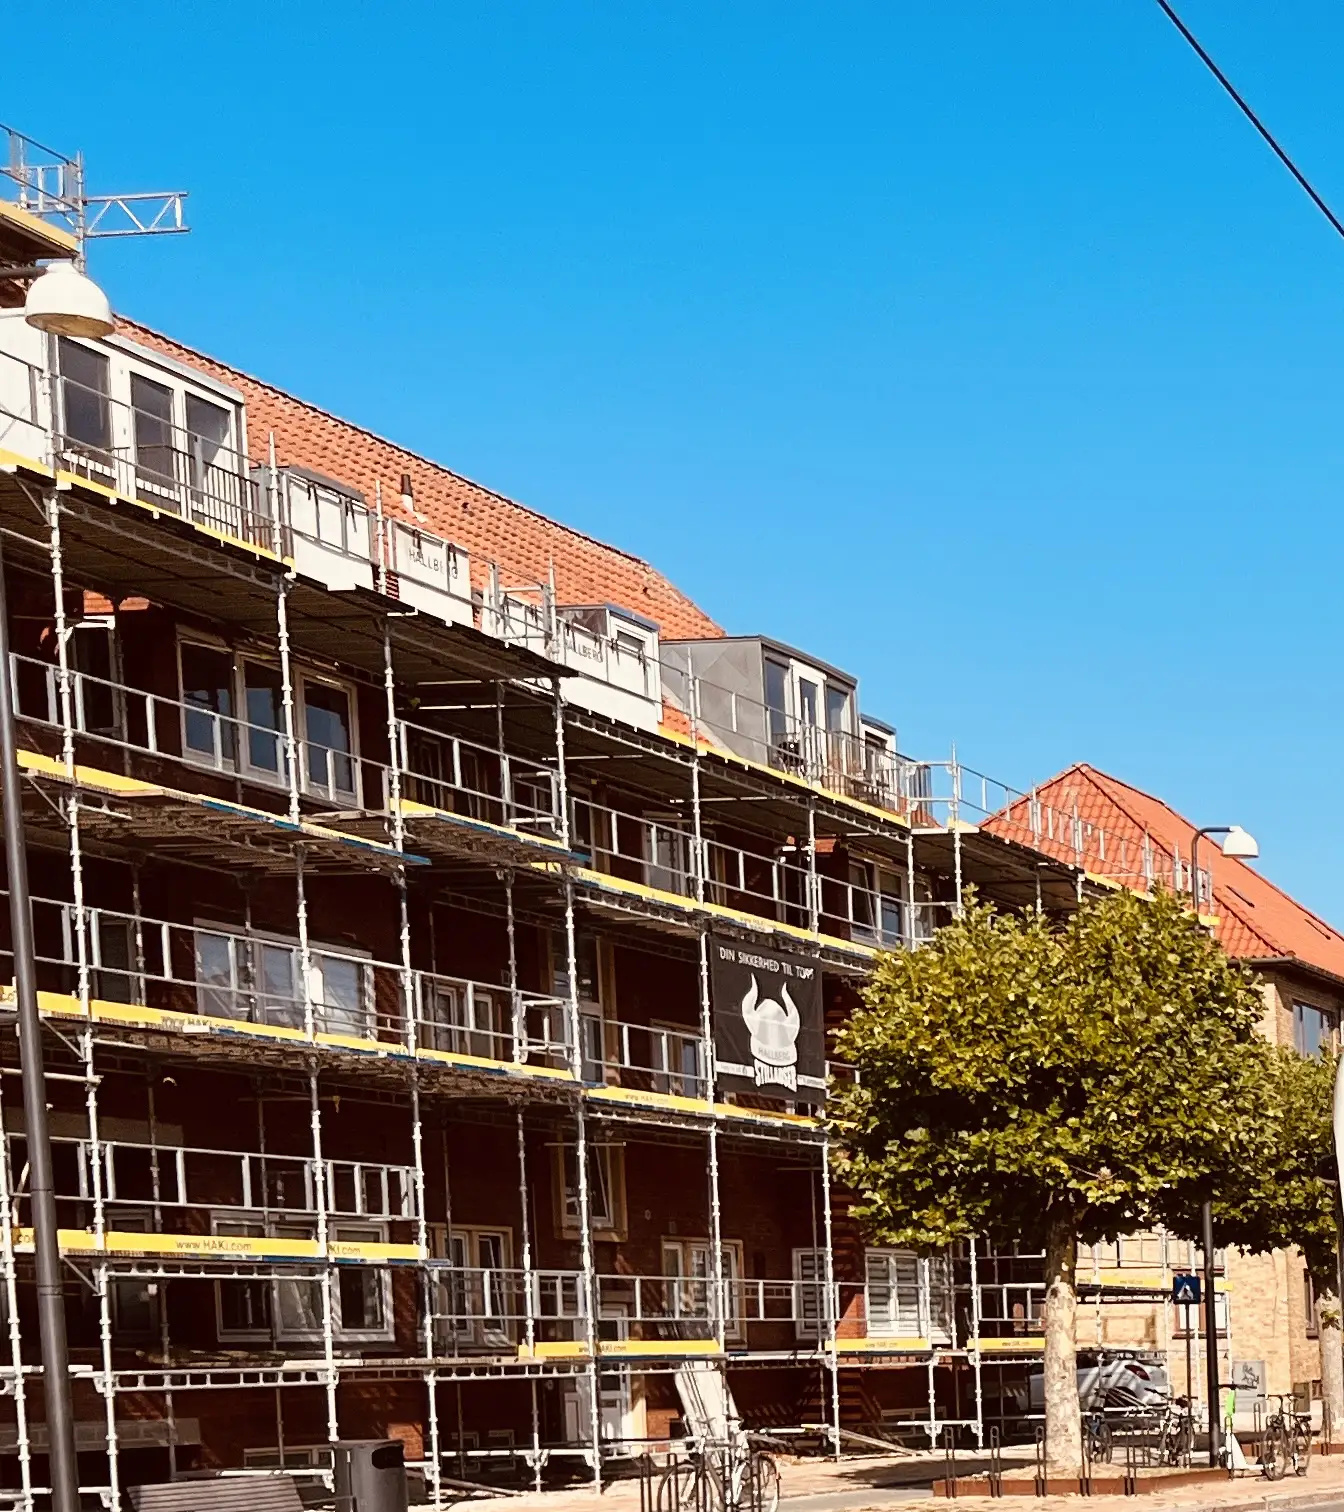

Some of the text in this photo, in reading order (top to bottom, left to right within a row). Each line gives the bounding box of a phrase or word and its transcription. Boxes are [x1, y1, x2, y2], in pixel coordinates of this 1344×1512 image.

[408, 546, 458, 580] HALLBEG
[719, 946, 736, 962] DIN
[738, 951, 780, 973] SIKKERHED
[781, 961, 794, 978] TIL
